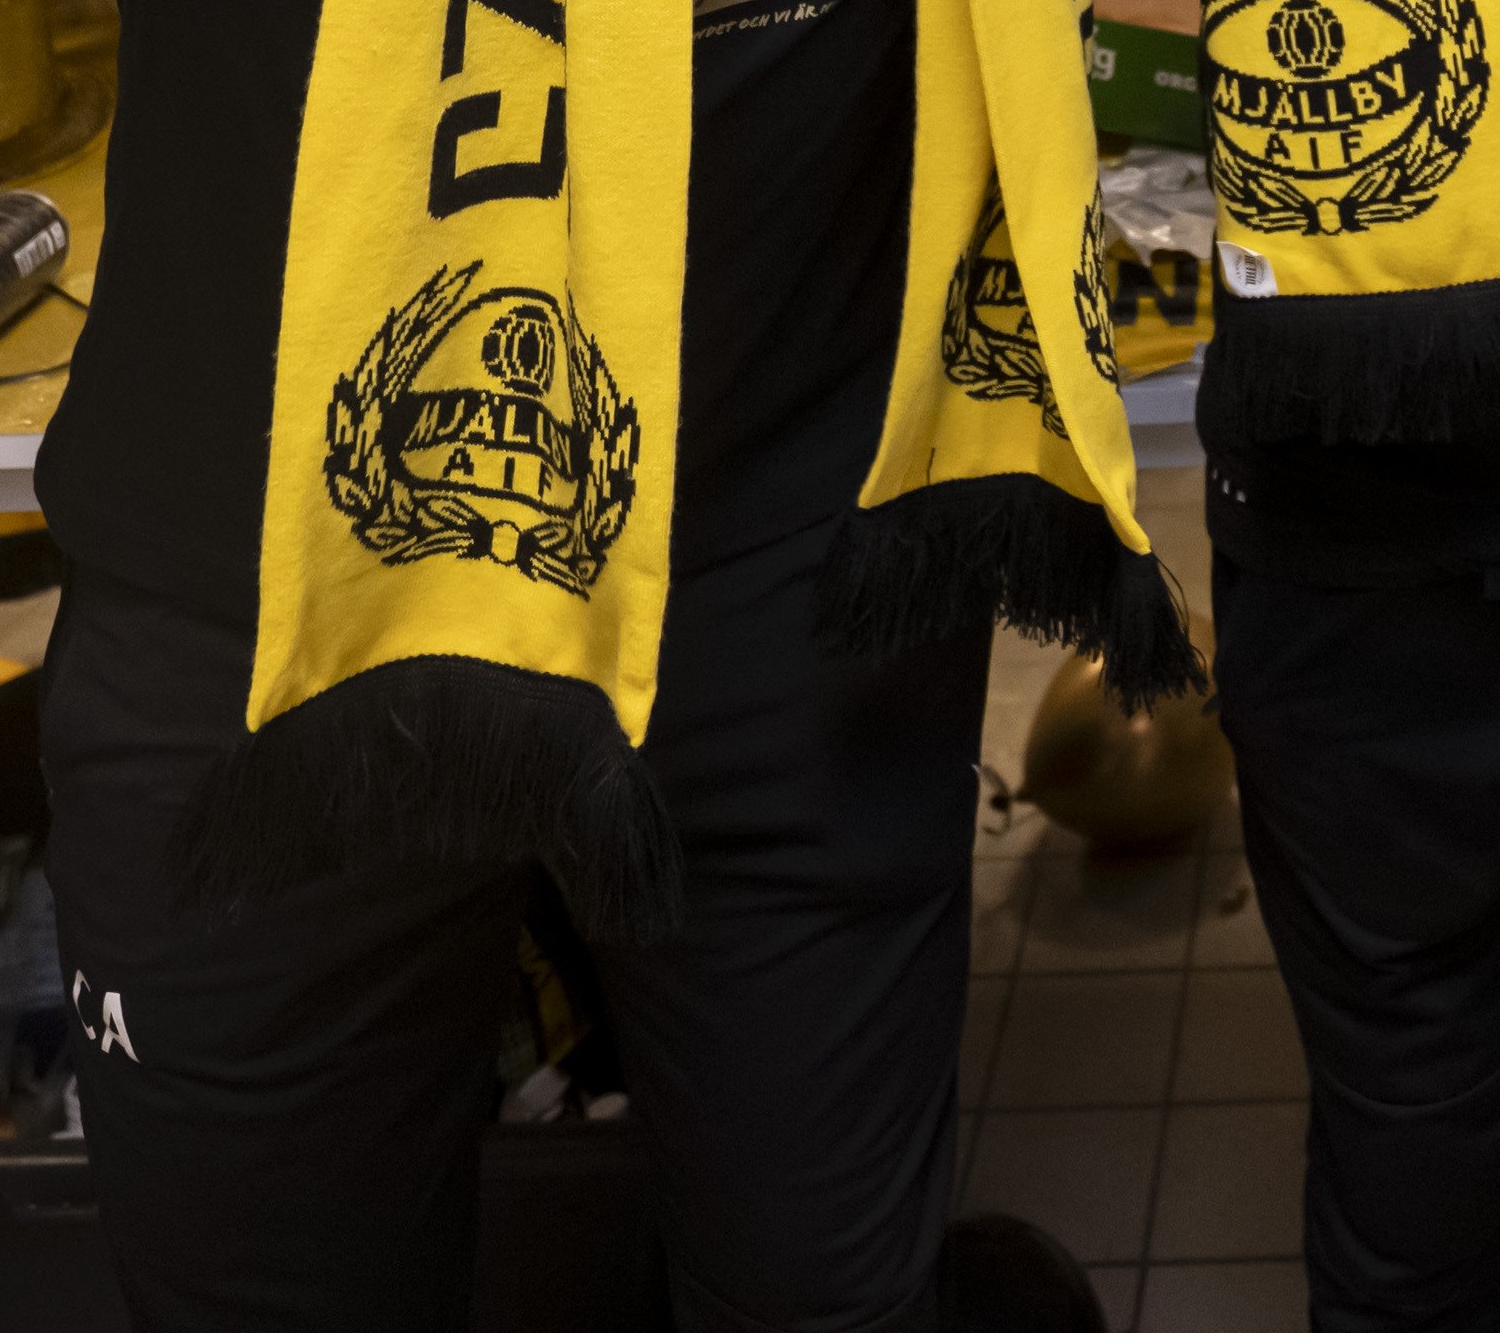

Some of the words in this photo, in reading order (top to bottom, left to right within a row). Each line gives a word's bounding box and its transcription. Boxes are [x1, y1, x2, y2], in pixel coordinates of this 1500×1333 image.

[738, 14, 770, 30] OCH
[774, 10, 792, 24] VI
[794, 2, 820, 21] ÄR
[1212, 63, 1407, 125] MJÄLLBY
[1265, 130, 1363, 170] AIF
[442, 446, 552, 499] AIF
